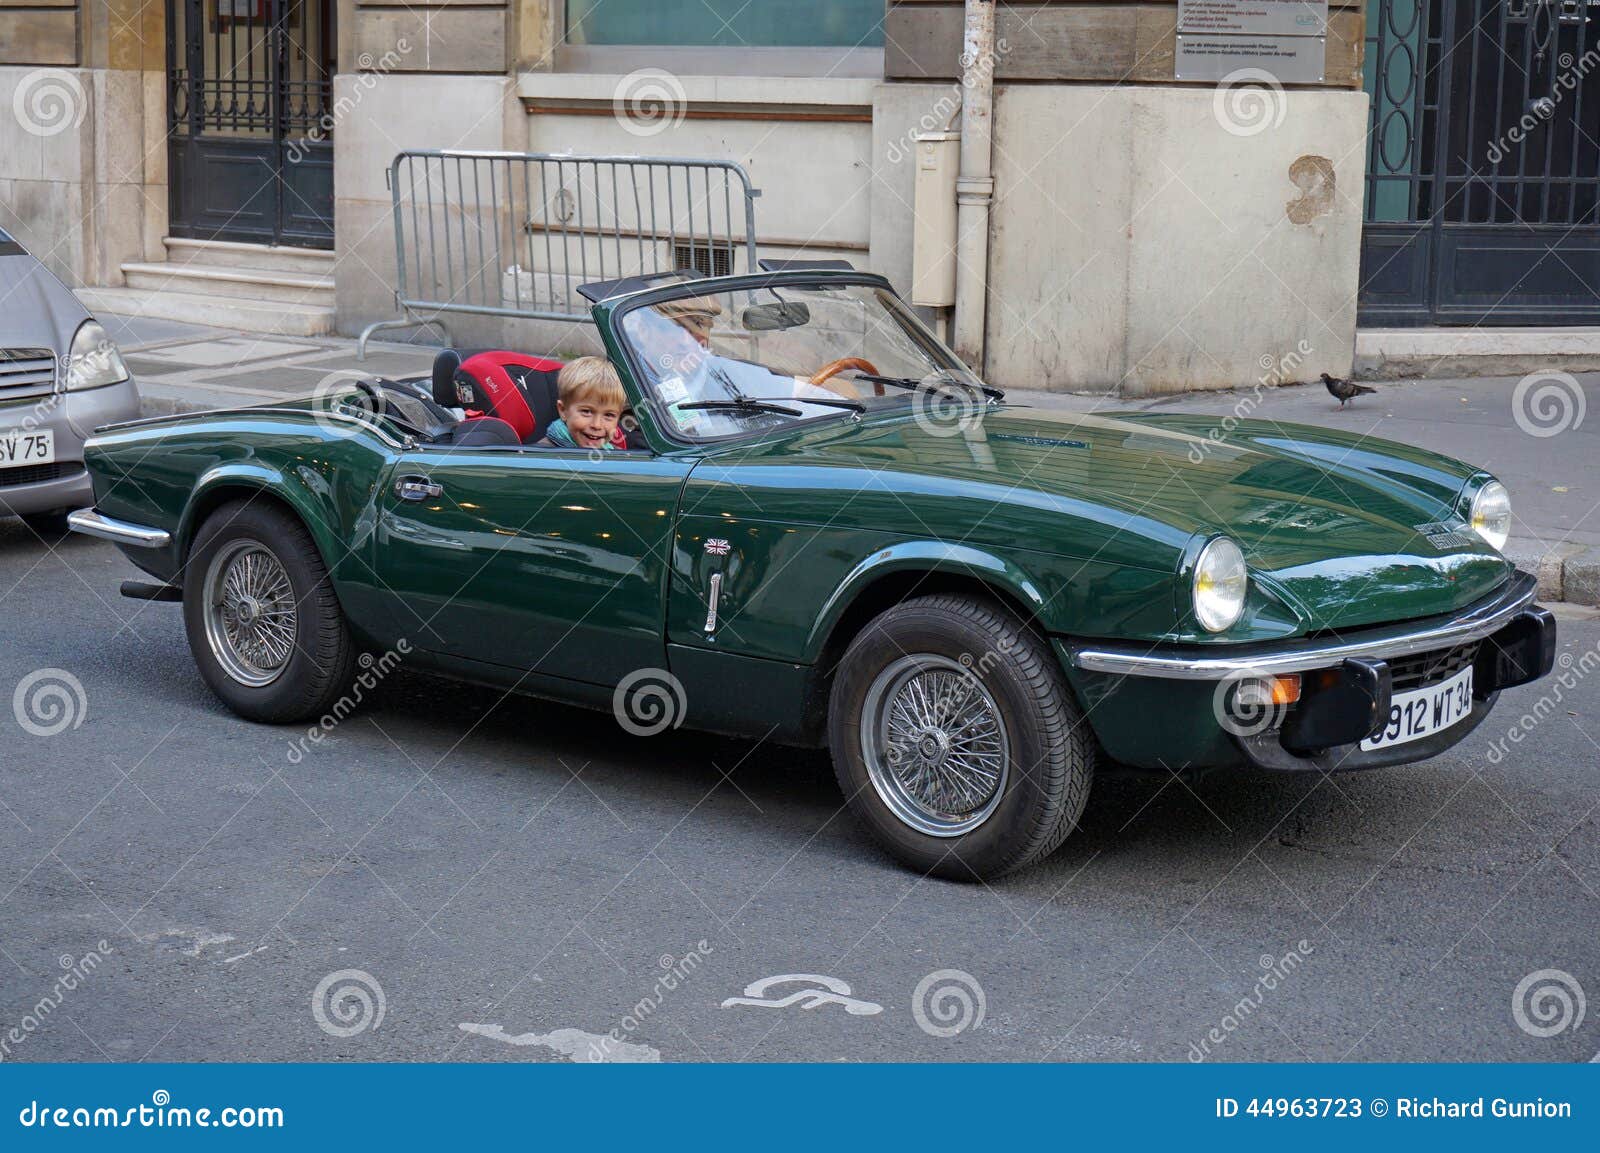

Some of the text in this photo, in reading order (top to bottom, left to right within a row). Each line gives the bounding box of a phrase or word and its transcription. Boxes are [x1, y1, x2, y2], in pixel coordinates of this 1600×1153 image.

[24, 435, 47, 459] 75
[1433, 687, 1454, 728] WT
[1456, 676, 1471, 716] 34
